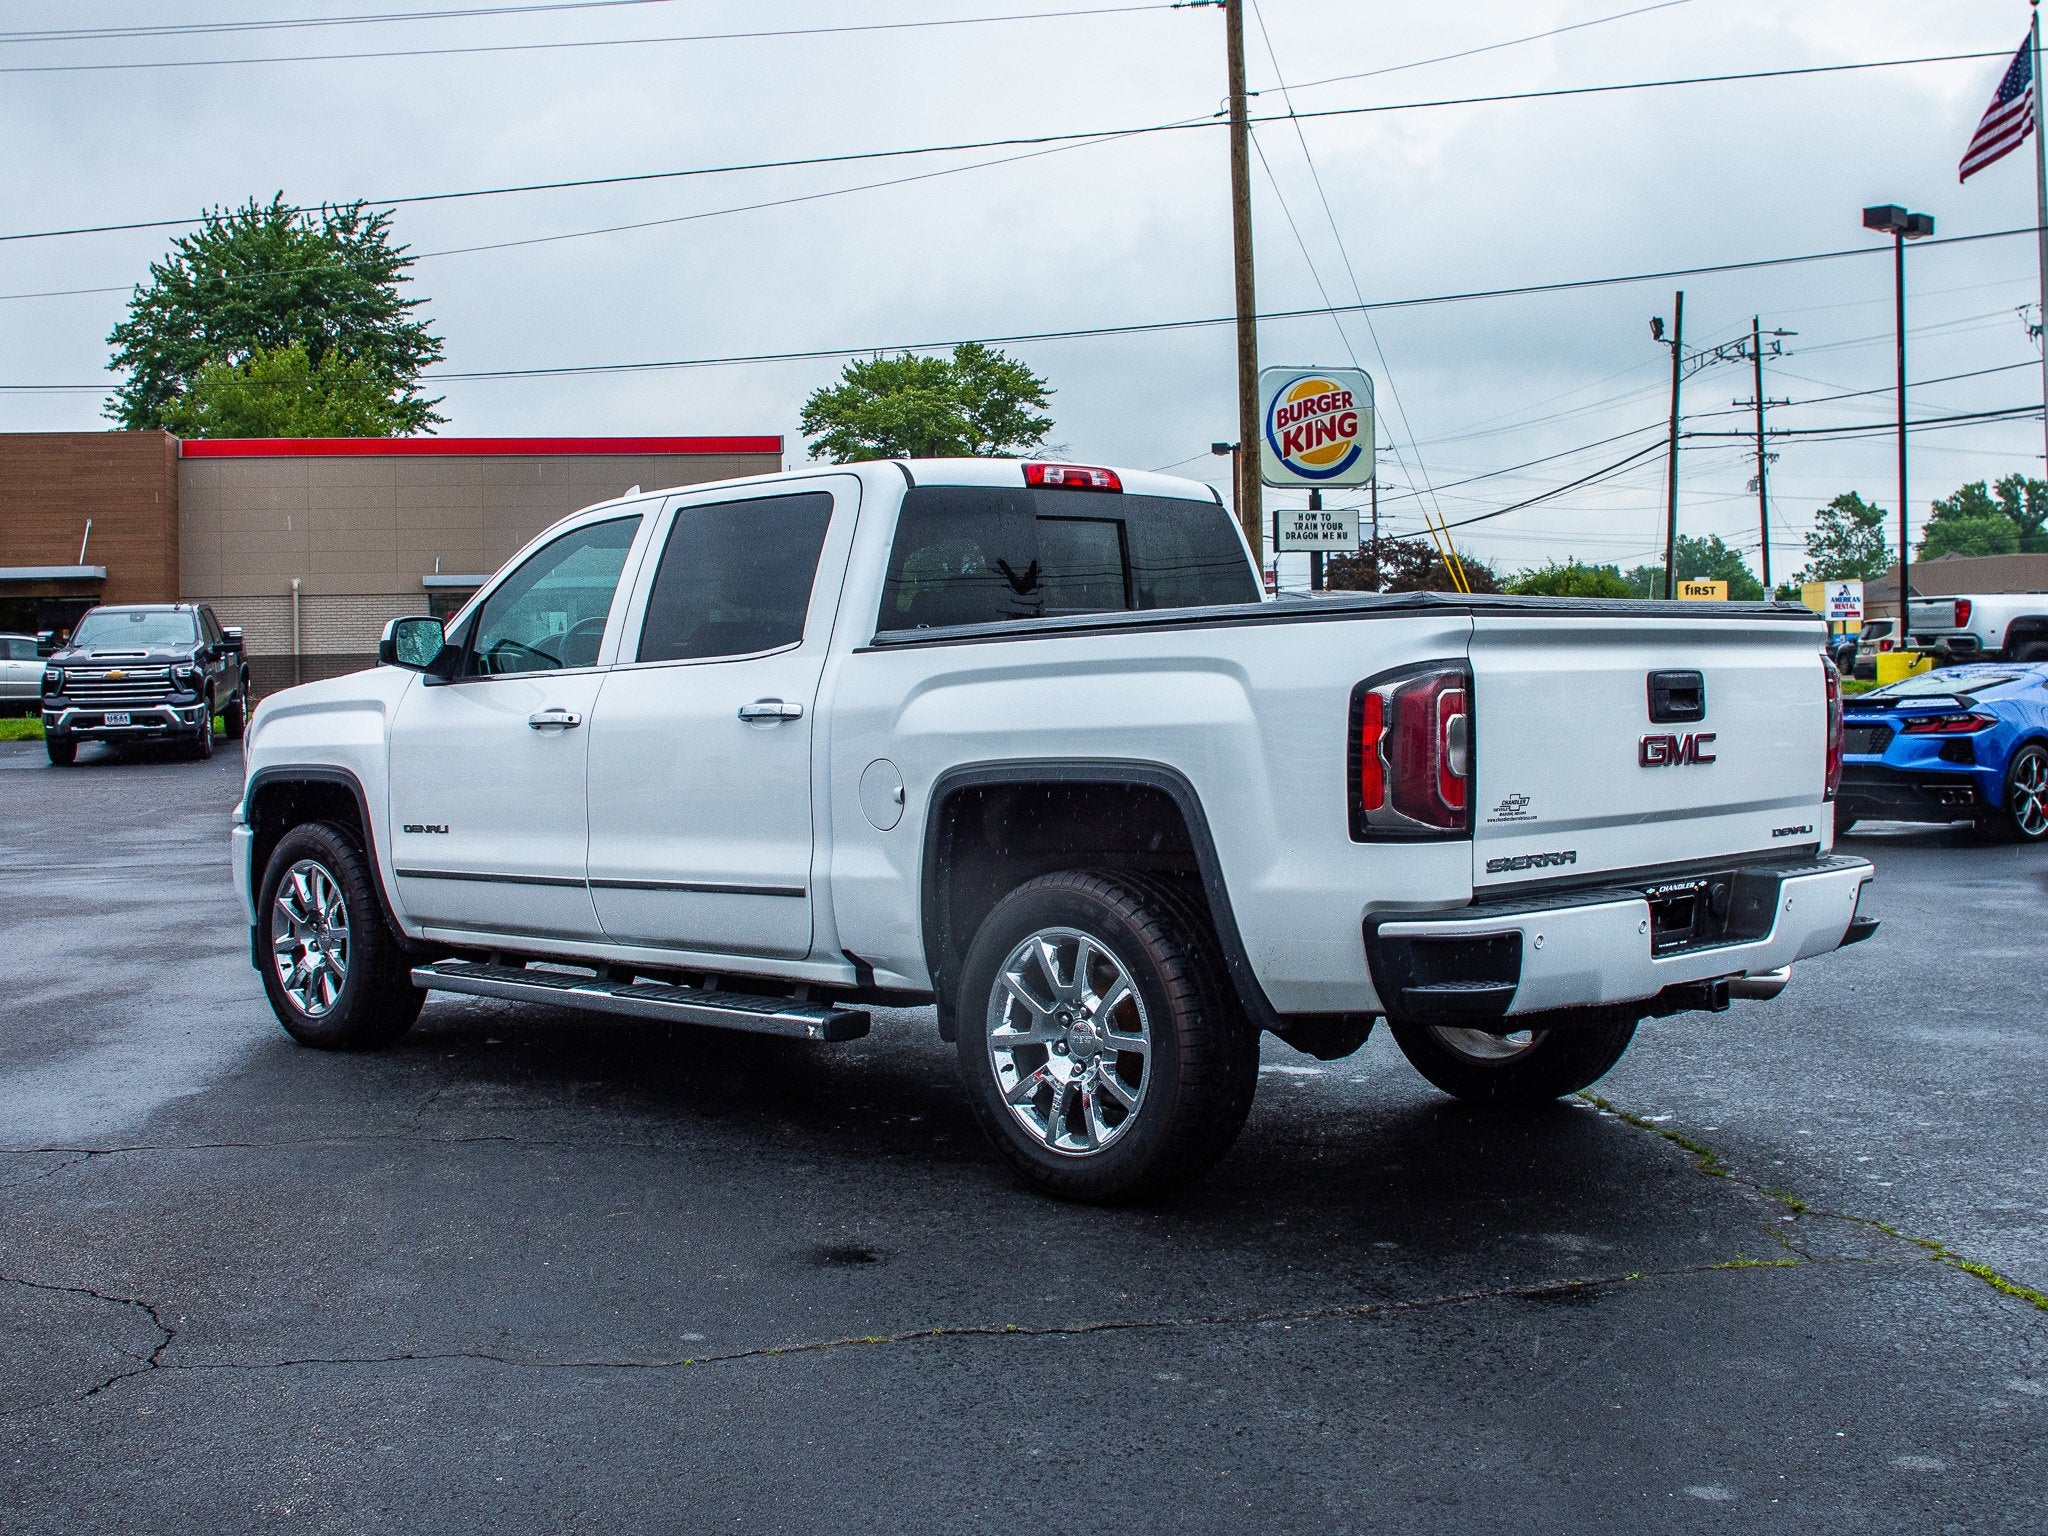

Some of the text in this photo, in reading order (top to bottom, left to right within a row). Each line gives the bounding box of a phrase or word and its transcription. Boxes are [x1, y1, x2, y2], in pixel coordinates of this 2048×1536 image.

[1277, 391, 1353, 429] BURGER
[1282, 411, 1358, 458] KING
[1298, 513, 1332, 521] HOW TO
[1293, 522, 1344, 531] TRAIN YOUR
[1285, 531, 1319, 540] DRAGON
[1638, 732, 1716, 767] GMC
[403, 824, 449, 834] DENALI
[1772, 824, 1813, 838] DENALI
[1486, 850, 1577, 874] SIERRA
[1658, 882, 1696, 893] CHANDLER
